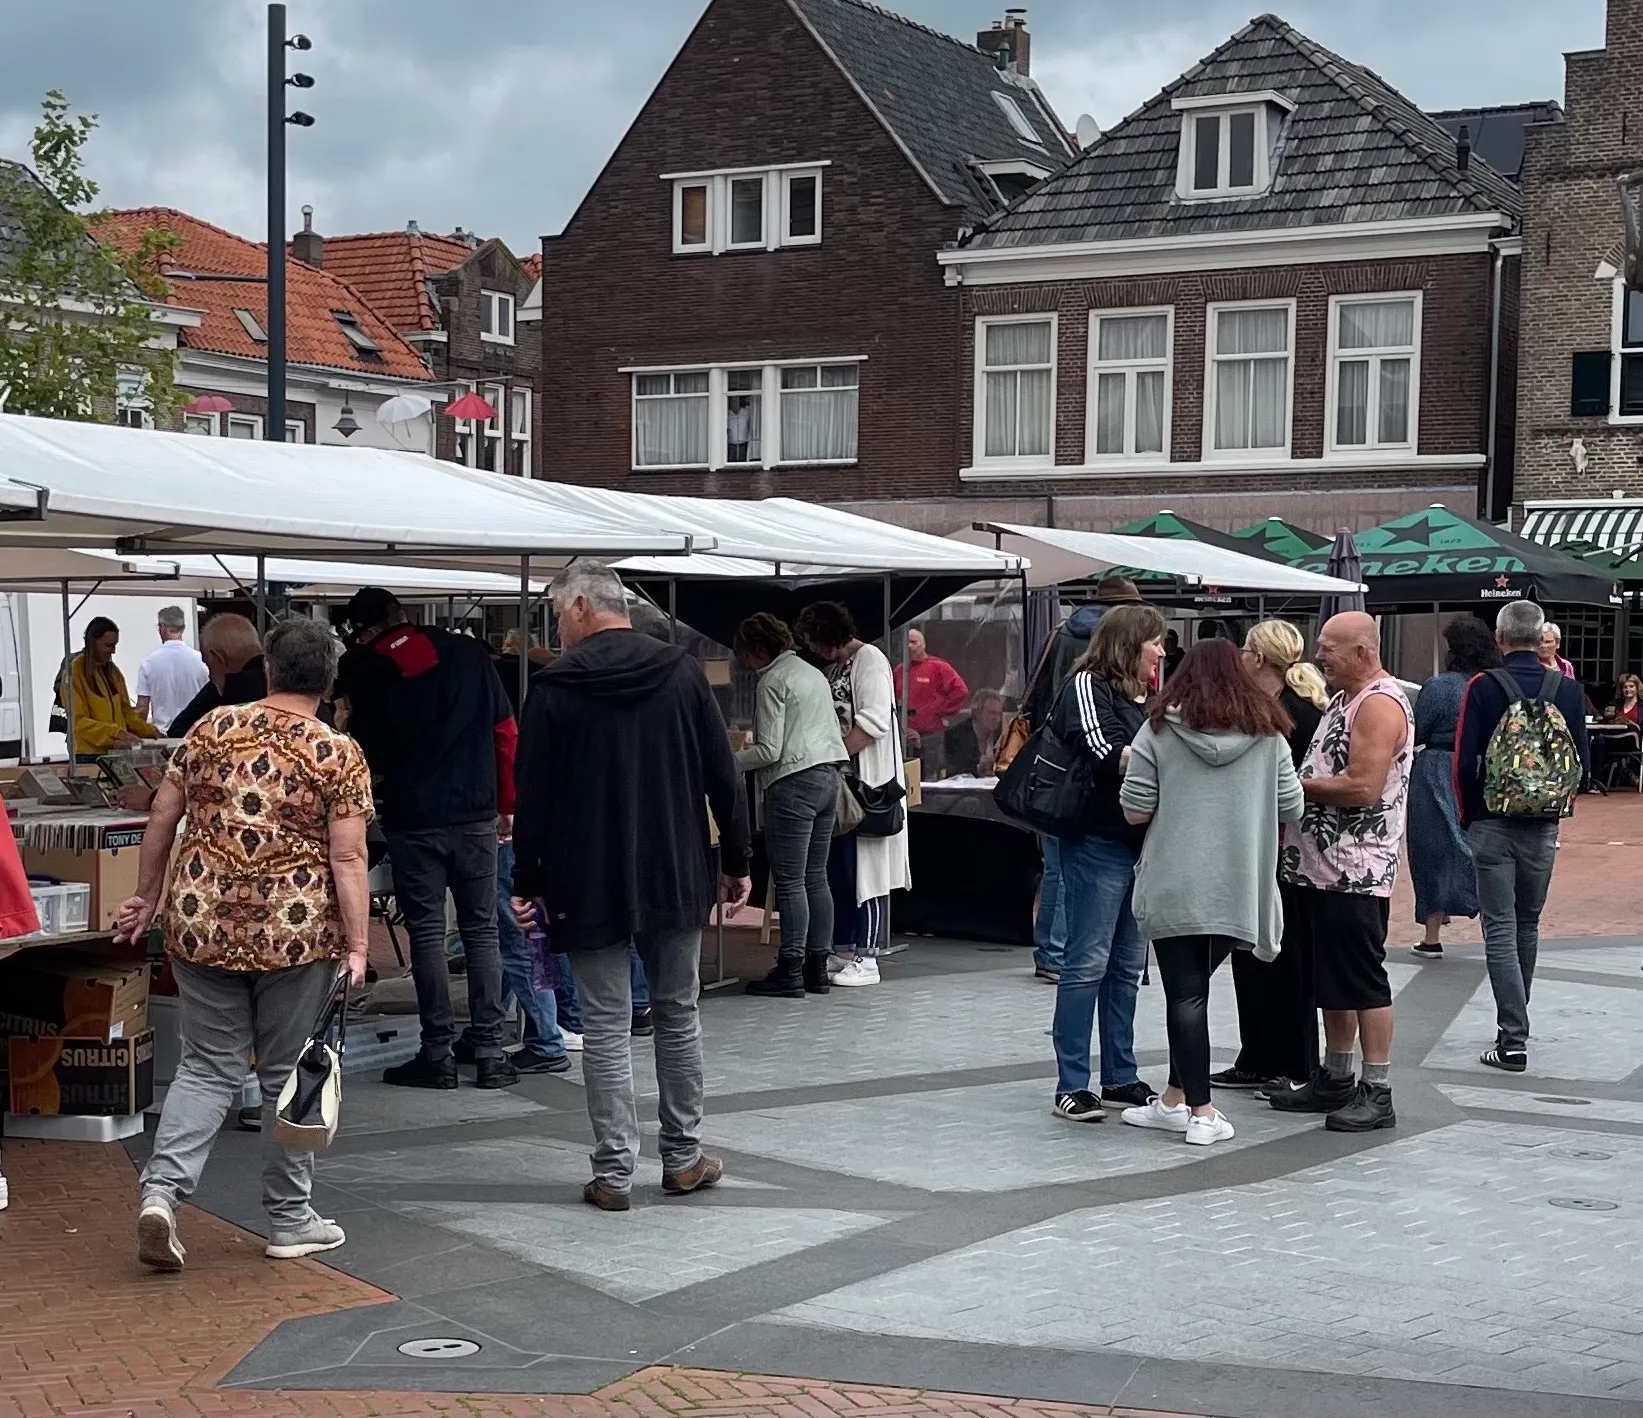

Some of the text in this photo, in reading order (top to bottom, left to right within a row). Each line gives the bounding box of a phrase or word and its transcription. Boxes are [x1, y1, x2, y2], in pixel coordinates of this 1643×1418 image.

[1480, 588, 1522, 598] Heineken
[108, 834, 130, 847] TONY
[61, 1048, 130, 1067] CITRUS
